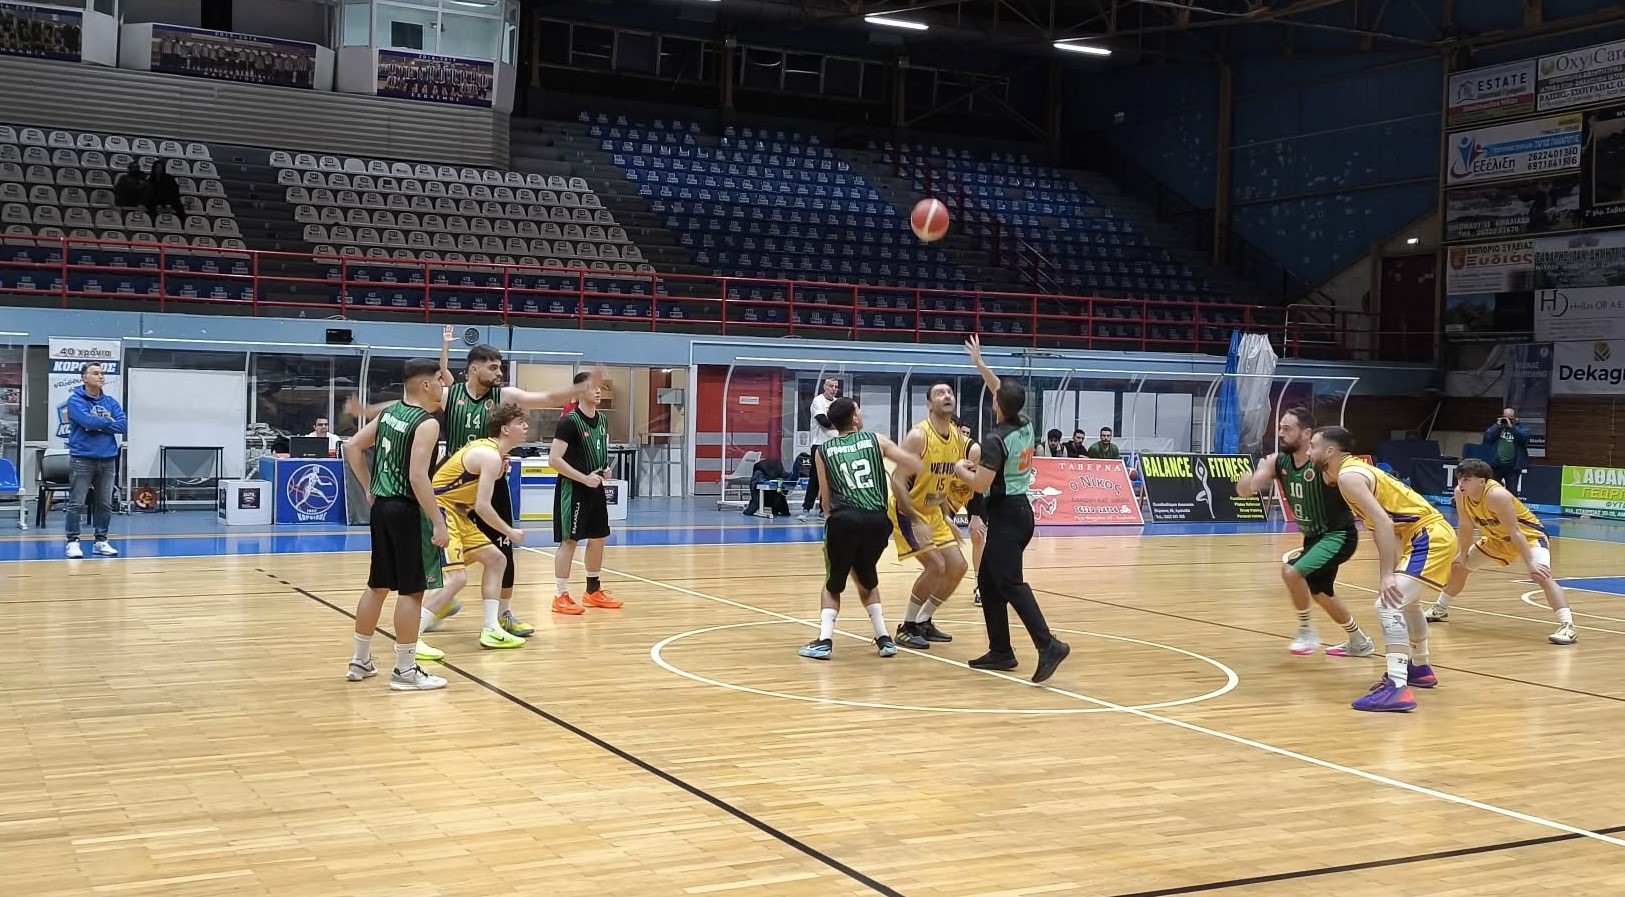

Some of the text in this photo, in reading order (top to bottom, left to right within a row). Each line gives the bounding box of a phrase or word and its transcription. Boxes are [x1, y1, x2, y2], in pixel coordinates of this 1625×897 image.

[1477, 73, 1526, 91] ESTATE
[1468, 245, 1500, 254] ΕΜΠΟΡΙΟ
[60, 347, 74, 356] 40
[465, 412, 480, 429] 14
[839, 458, 874, 490] 12
[1058, 462, 1121, 472] ΤΑΒΕΡΝΑ
[1142, 456, 1252, 478] BALANCE FITNESS
[936, 477, 945, 491] 15
[1290, 481, 1303, 499] 10
[497, 536, 510, 547] 14
